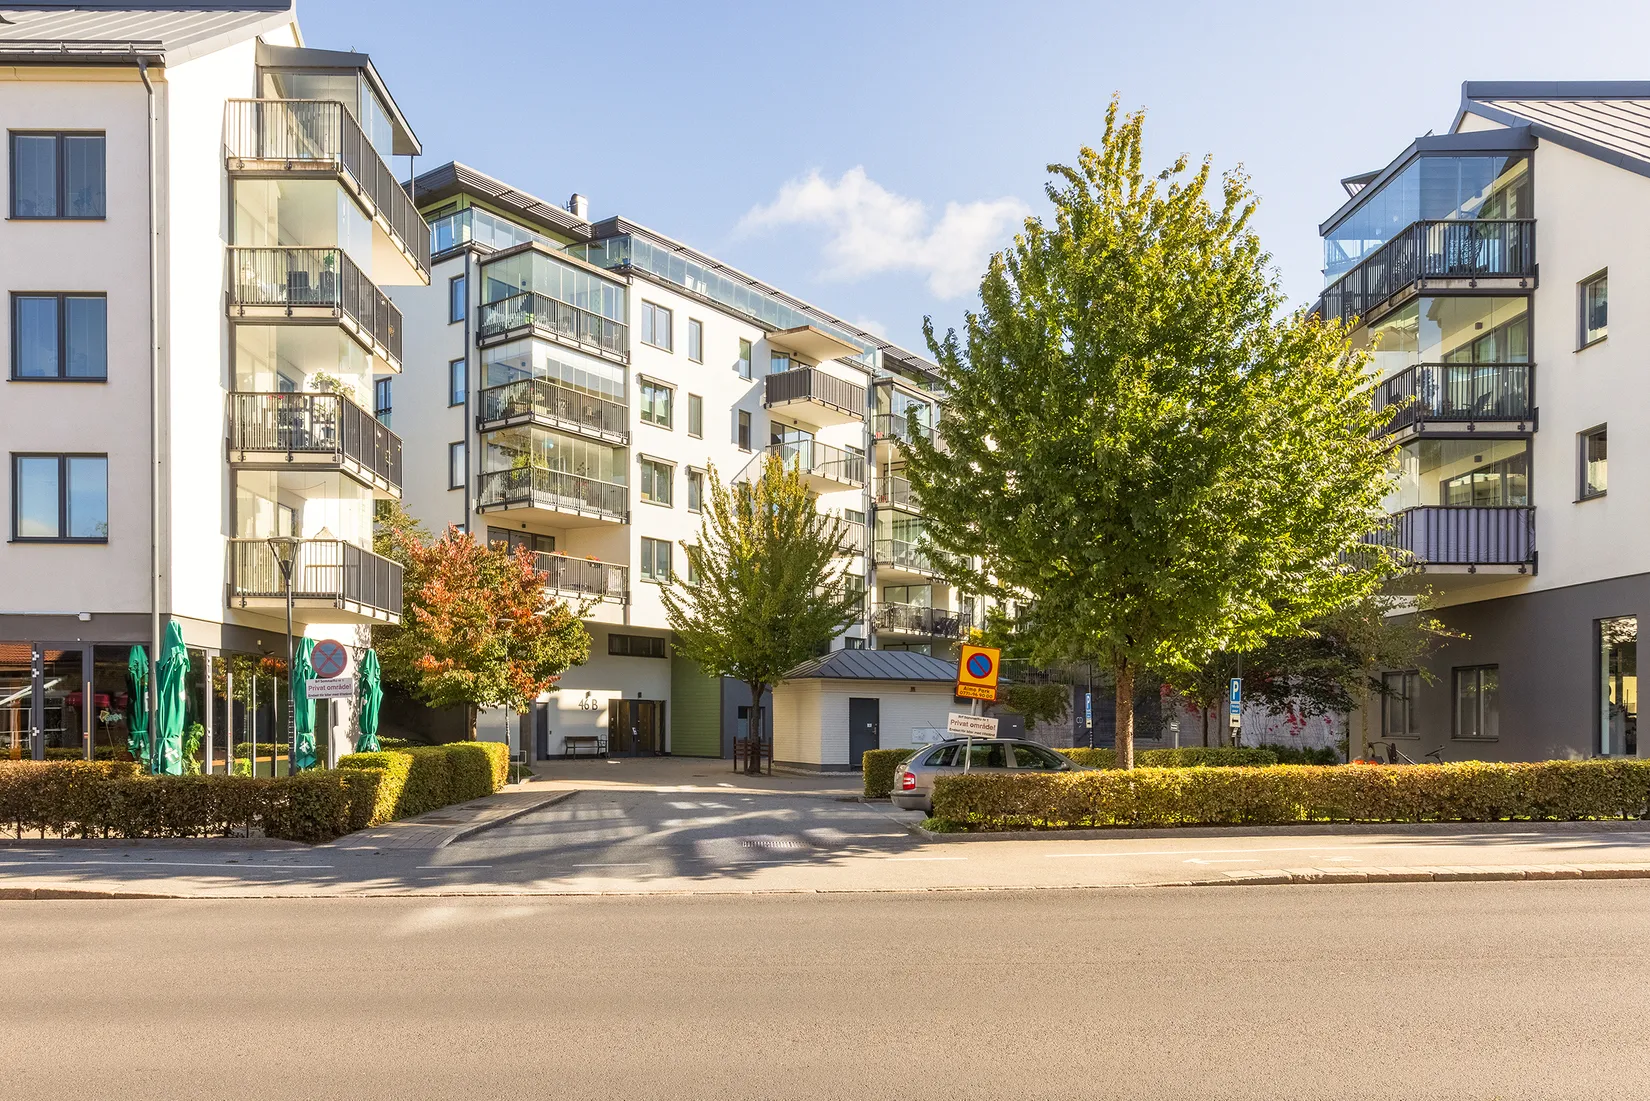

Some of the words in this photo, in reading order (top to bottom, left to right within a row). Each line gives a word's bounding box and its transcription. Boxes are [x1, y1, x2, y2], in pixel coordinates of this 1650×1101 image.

[1233, 681, 1238, 700] P
[578, 699, 589, 710] 46
[592, 699, 598, 710] B
